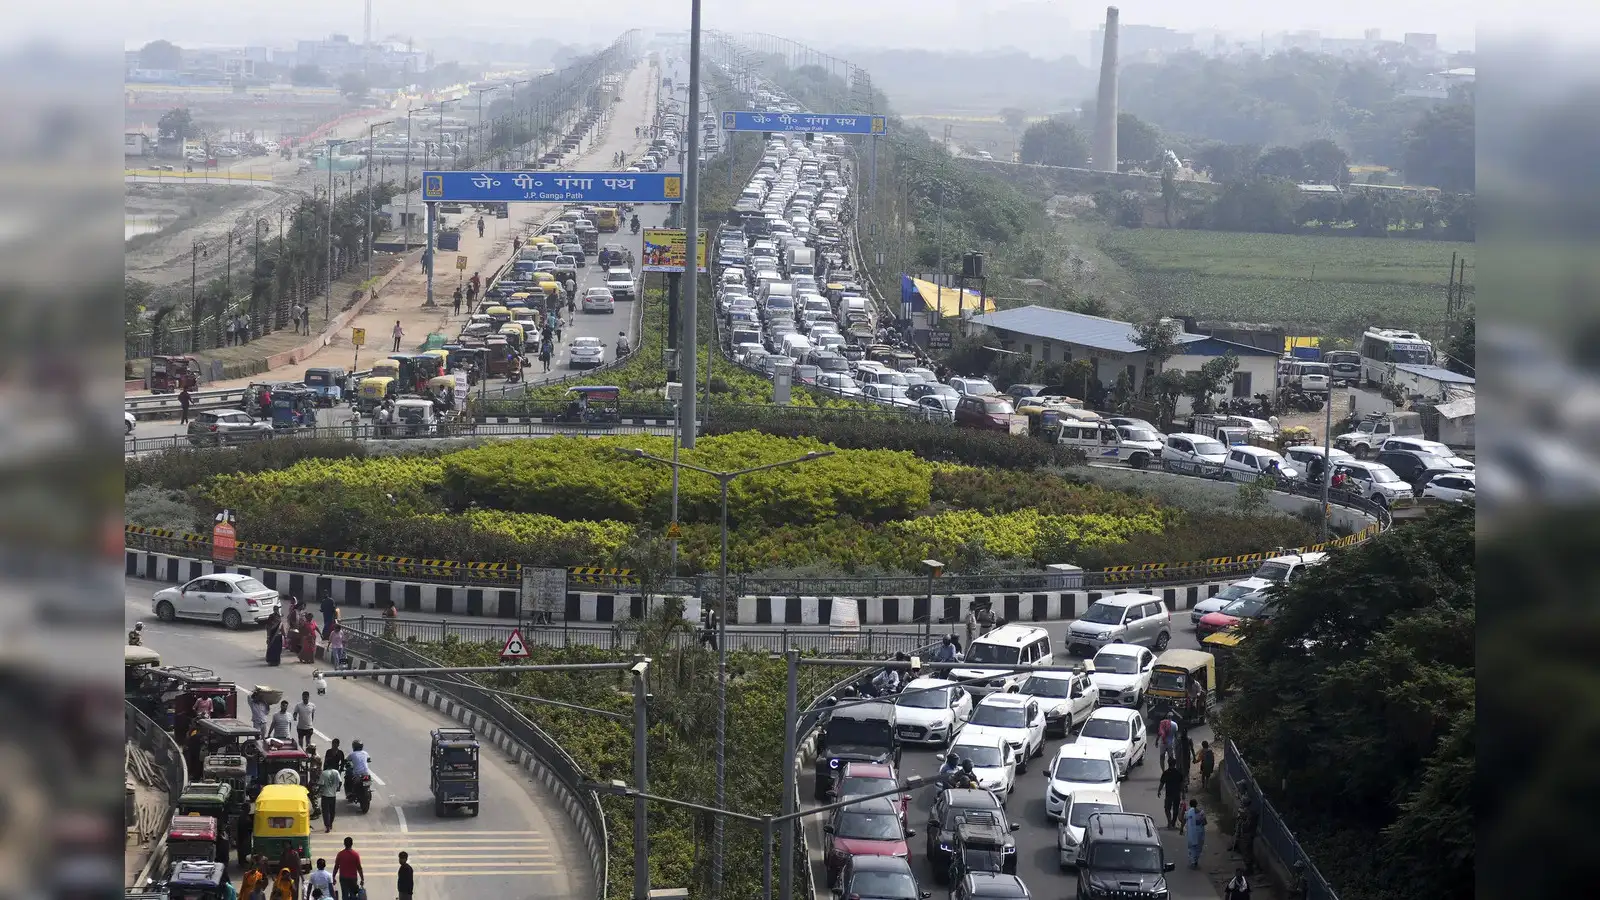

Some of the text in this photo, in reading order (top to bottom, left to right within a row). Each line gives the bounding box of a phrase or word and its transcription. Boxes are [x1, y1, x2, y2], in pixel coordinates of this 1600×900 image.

[804, 116, 830, 125] गंगा
[835, 117, 857, 126] पथ
[471, 173, 636, 190] जे० पी० गंगा पथ
[539, 192, 563, 200] Ganga
